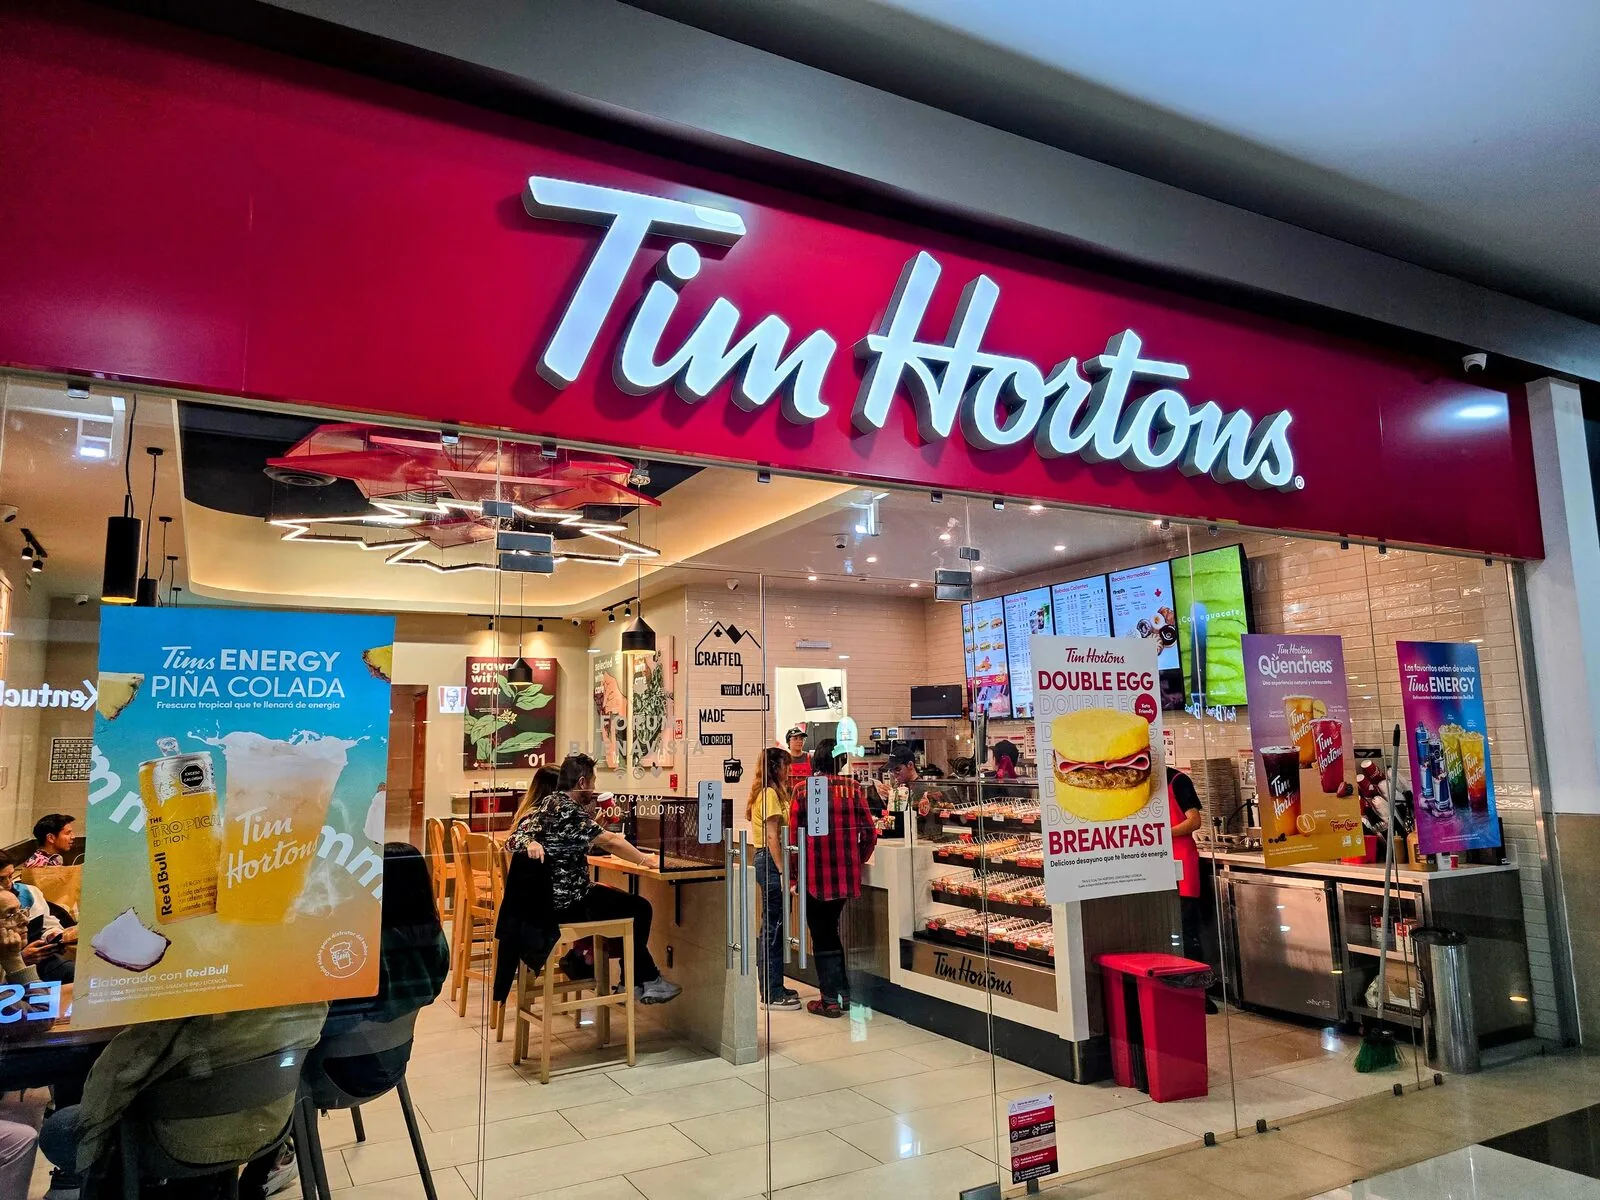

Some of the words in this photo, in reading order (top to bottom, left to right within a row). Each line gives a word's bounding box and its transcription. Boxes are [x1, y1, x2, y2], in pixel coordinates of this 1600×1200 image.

[524, 175, 837, 419] Tim
[855, 249, 1297, 489] Hortons
[161, 645, 216, 670] Tims
[220, 648, 341, 672] ENERGY
[697, 651, 741, 666] CRAFTED
[1065, 647, 1085, 663] Tim
[1085, 648, 1125, 664] Hortons
[1404, 663, 1414, 672] Los
[1414, 663, 1438, 672] favoritos
[1460, 664, 1476, 673] vuelta
[151, 669, 220, 698] PIÑA
[227, 675, 346, 698] COLADA
[1038, 670, 1113, 691] DOUBLE
[1116, 671, 1154, 691] EGG
[1406, 674, 1429, 692] Tims
[1428, 676, 1476, 693] ENERGY
[471, 686, 501, 696] care
[723, 685, 740, 695] WITH
[156, 700, 196, 709] Frescura
[198, 700, 232, 710] tropical
[234, 702, 251, 711] que
[263, 700, 293, 709] llenará
[295, 701, 307, 709] de
[699, 709, 726, 722] MADE
[701, 735, 709, 745] TO
[710, 735, 731, 745] ORDER
[1316, 732, 1333, 753] Tim
[1271, 775, 1290, 797] Tim
[632, 804, 665, 816] 10:00
[667, 803, 685, 815] hrs
[149, 816, 163, 825] THE
[235, 806, 293, 846] Tim
[1048, 822, 1166, 856] BREAKFAST
[1050, 859, 1076, 868] Delicioso
[1076, 856, 1103, 866] desayuno
[1103, 854, 1115, 864] que
[1121, 851, 1140, 860] llenará
[1140, 851, 1148, 859] de
[933, 951, 957, 980] Tim
[90, 972, 157, 989] Elaborado
[159, 971, 182, 981] con
